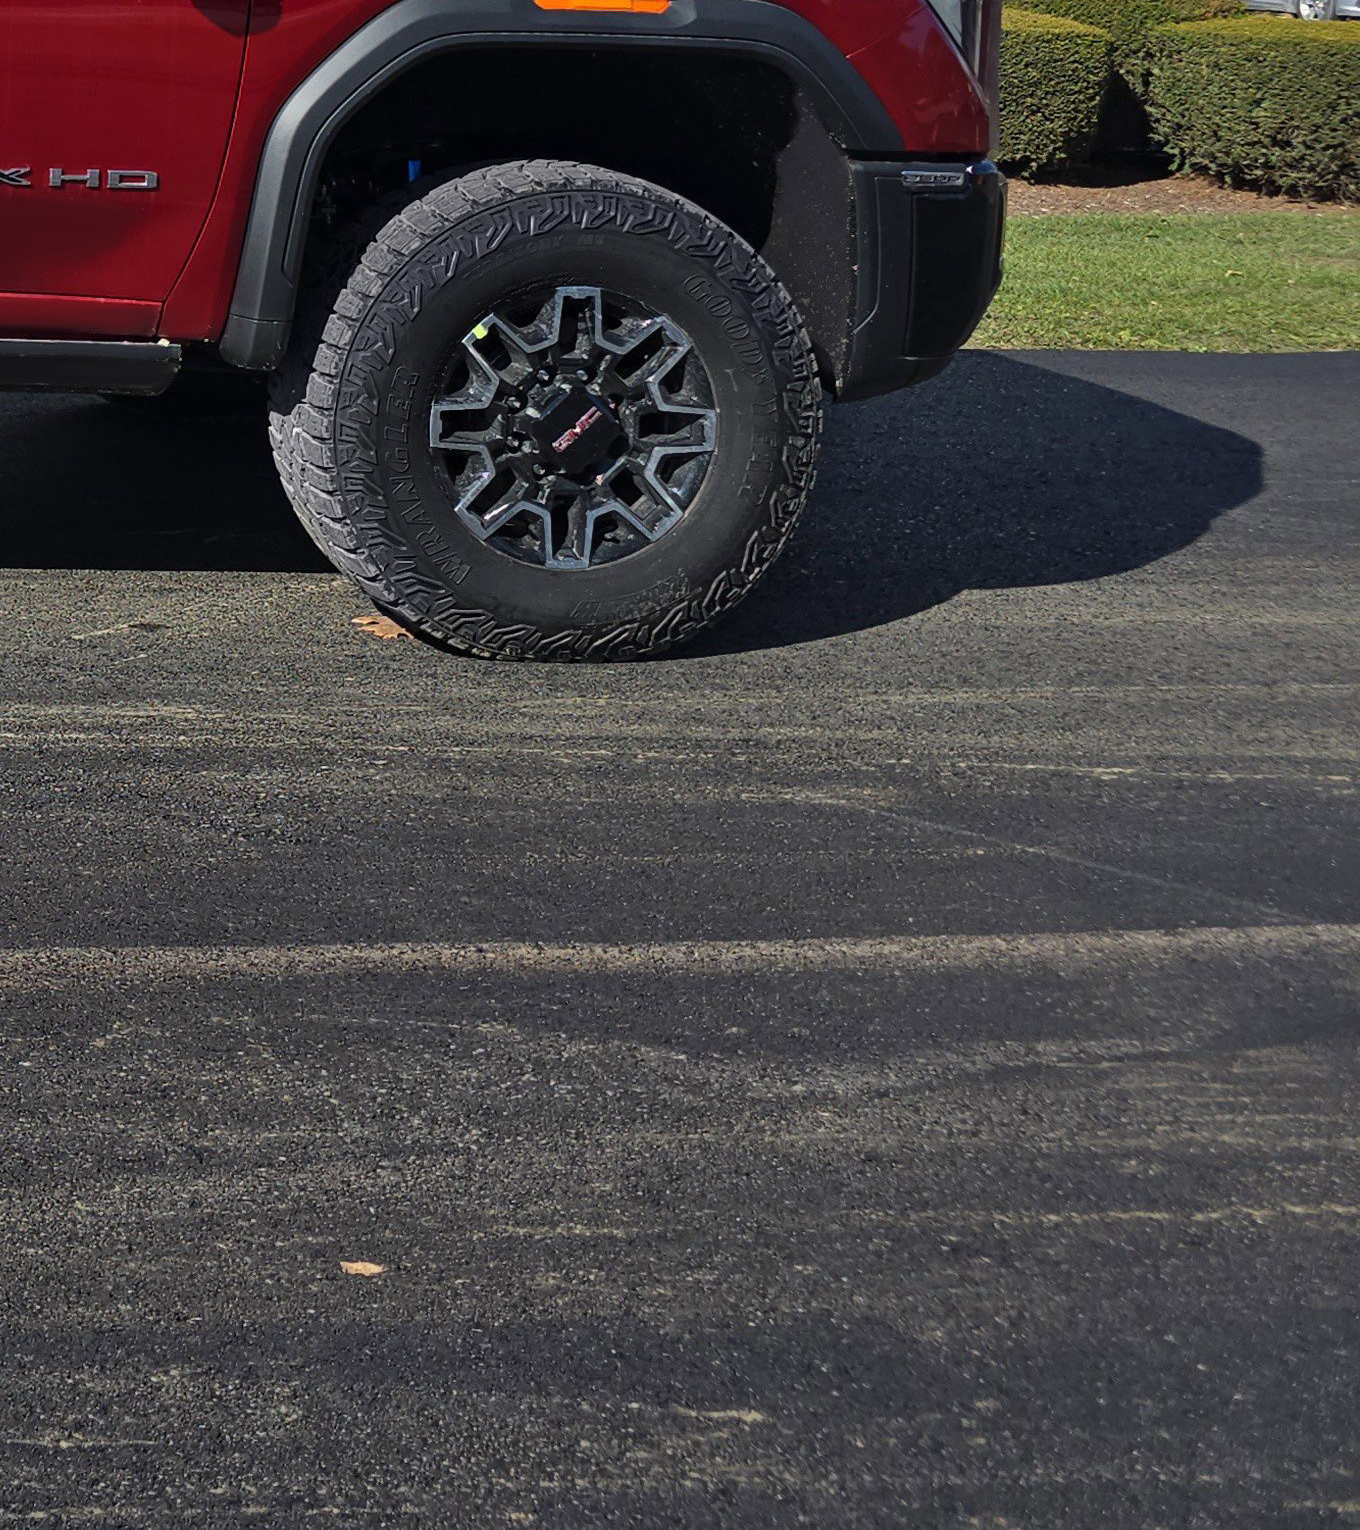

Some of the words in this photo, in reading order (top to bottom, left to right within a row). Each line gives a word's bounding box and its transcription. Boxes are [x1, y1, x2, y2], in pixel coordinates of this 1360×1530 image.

[48, 168, 158, 189] HD
[552, 405, 602, 453] GMC
[384, 366, 473, 585] WRANGLER
